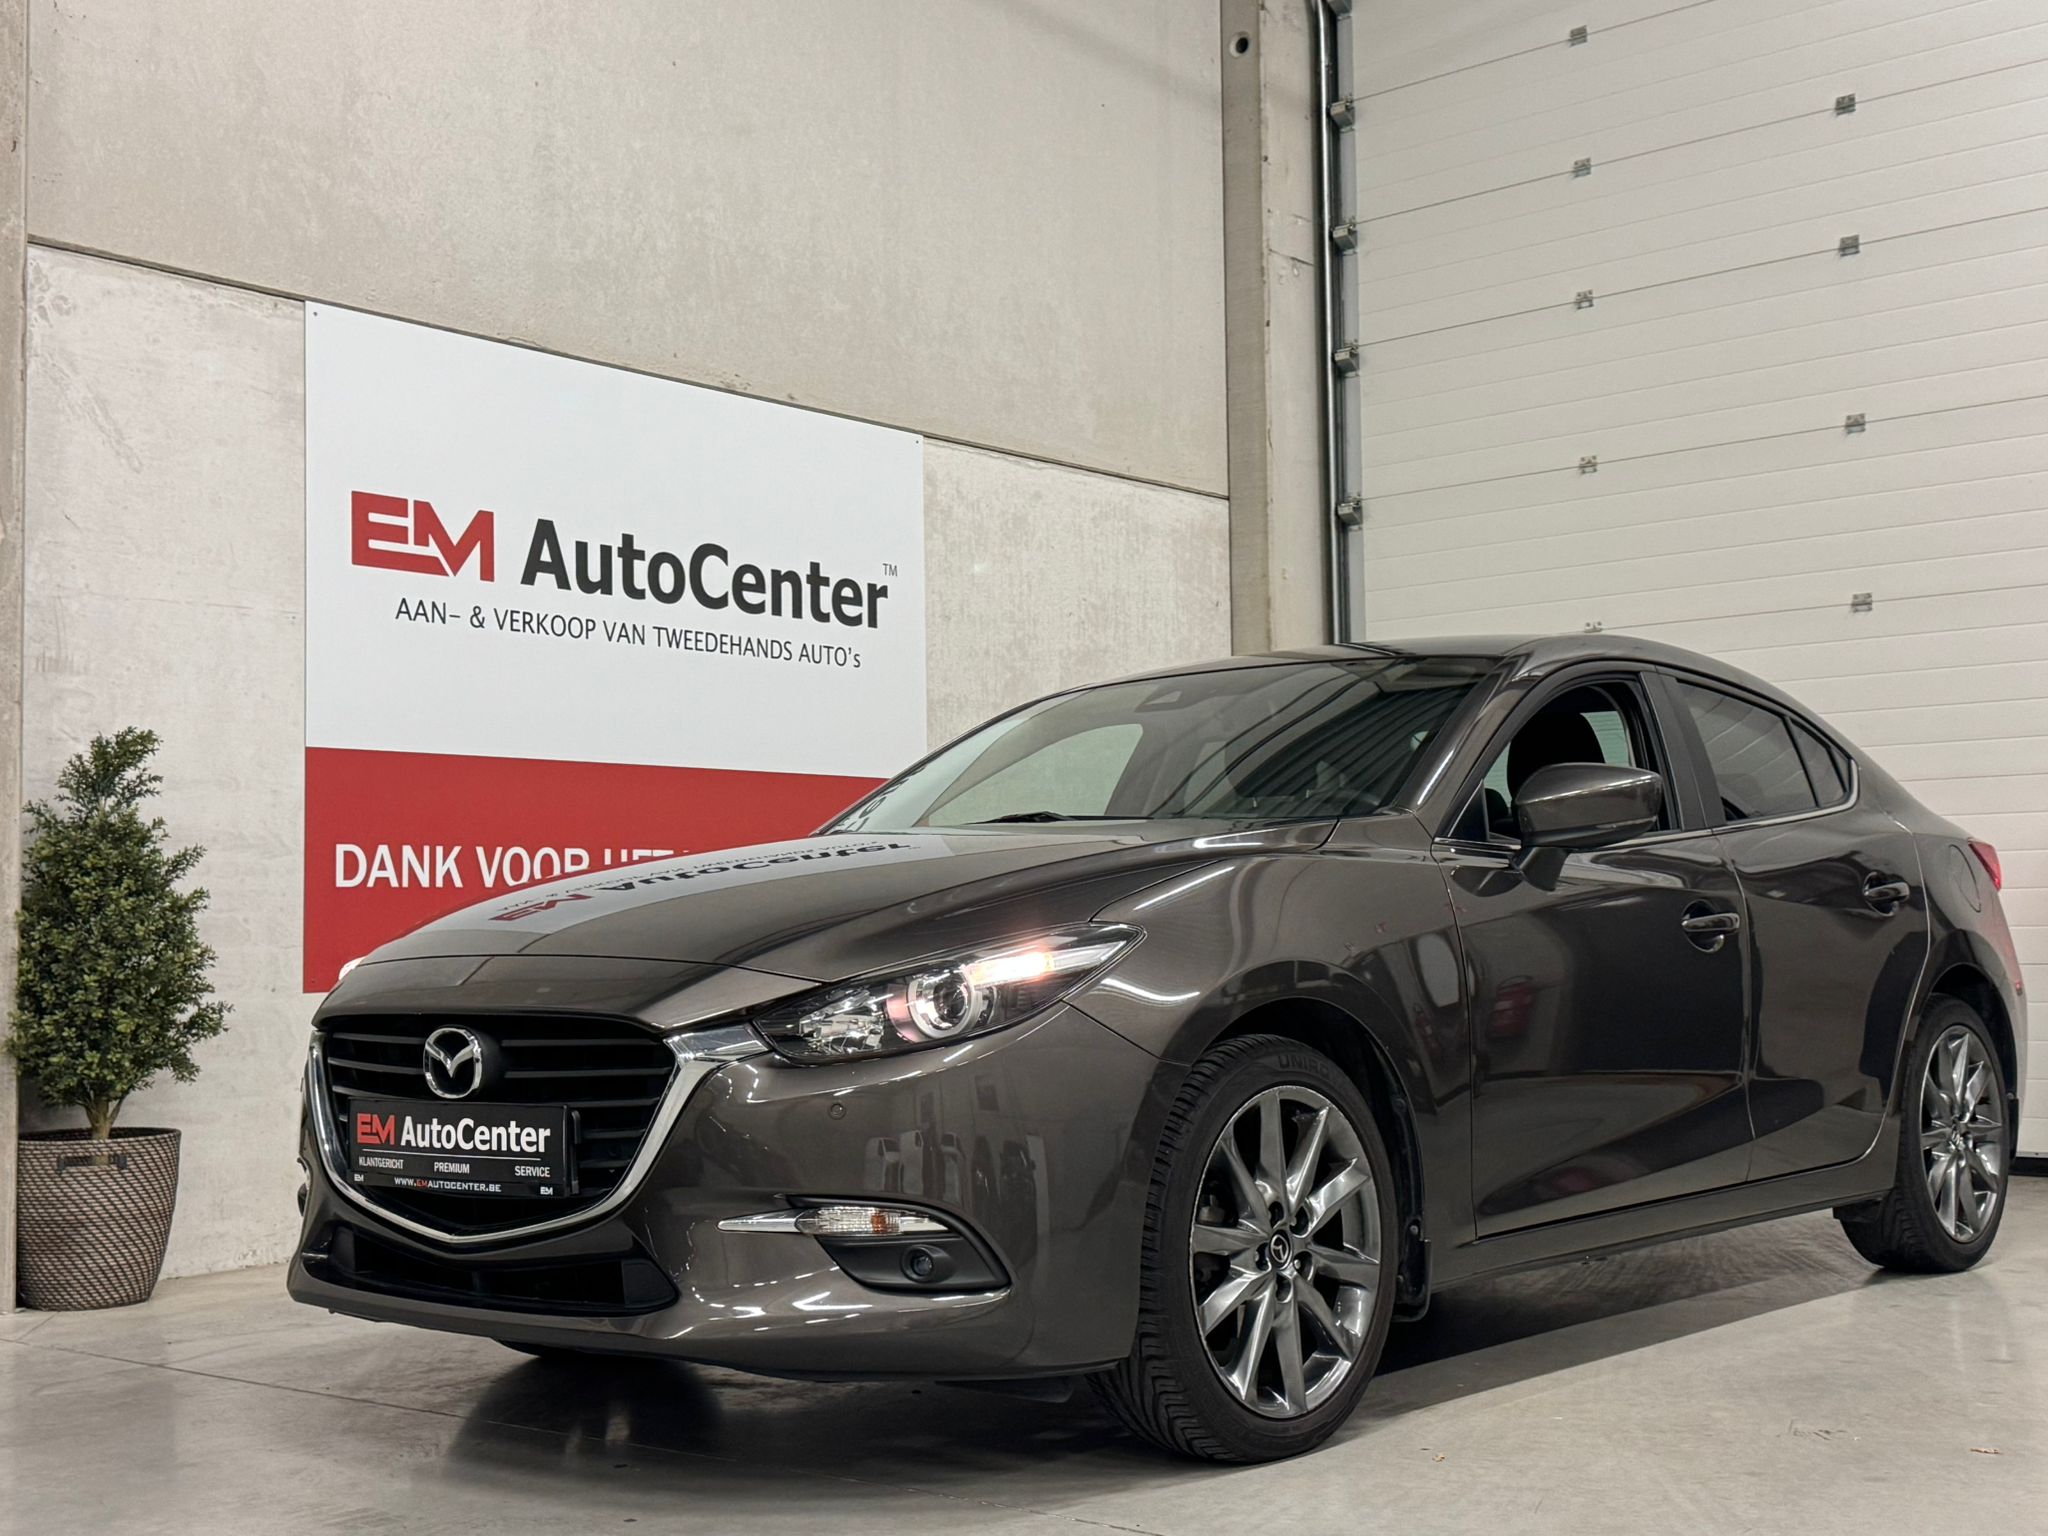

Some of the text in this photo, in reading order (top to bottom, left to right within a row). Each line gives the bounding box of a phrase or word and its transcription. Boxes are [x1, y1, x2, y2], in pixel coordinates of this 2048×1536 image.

[351, 490, 494, 582] EM
[520, 518, 888, 628] AutoCenter
[469, 605, 486, 630] &
[494, 608, 597, 640] VERKOOP
[603, 621, 646, 646] VAN
[652, 626, 793, 662] TWEEDEHANDS
[799, 643, 861, 669] AUTO's
[335, 843, 463, 888] DANK
[357, 1113, 551, 1153] EM AutoCenter
[358, 1156, 551, 1178] KLANTGERICHT PREMIUM SERVICE
